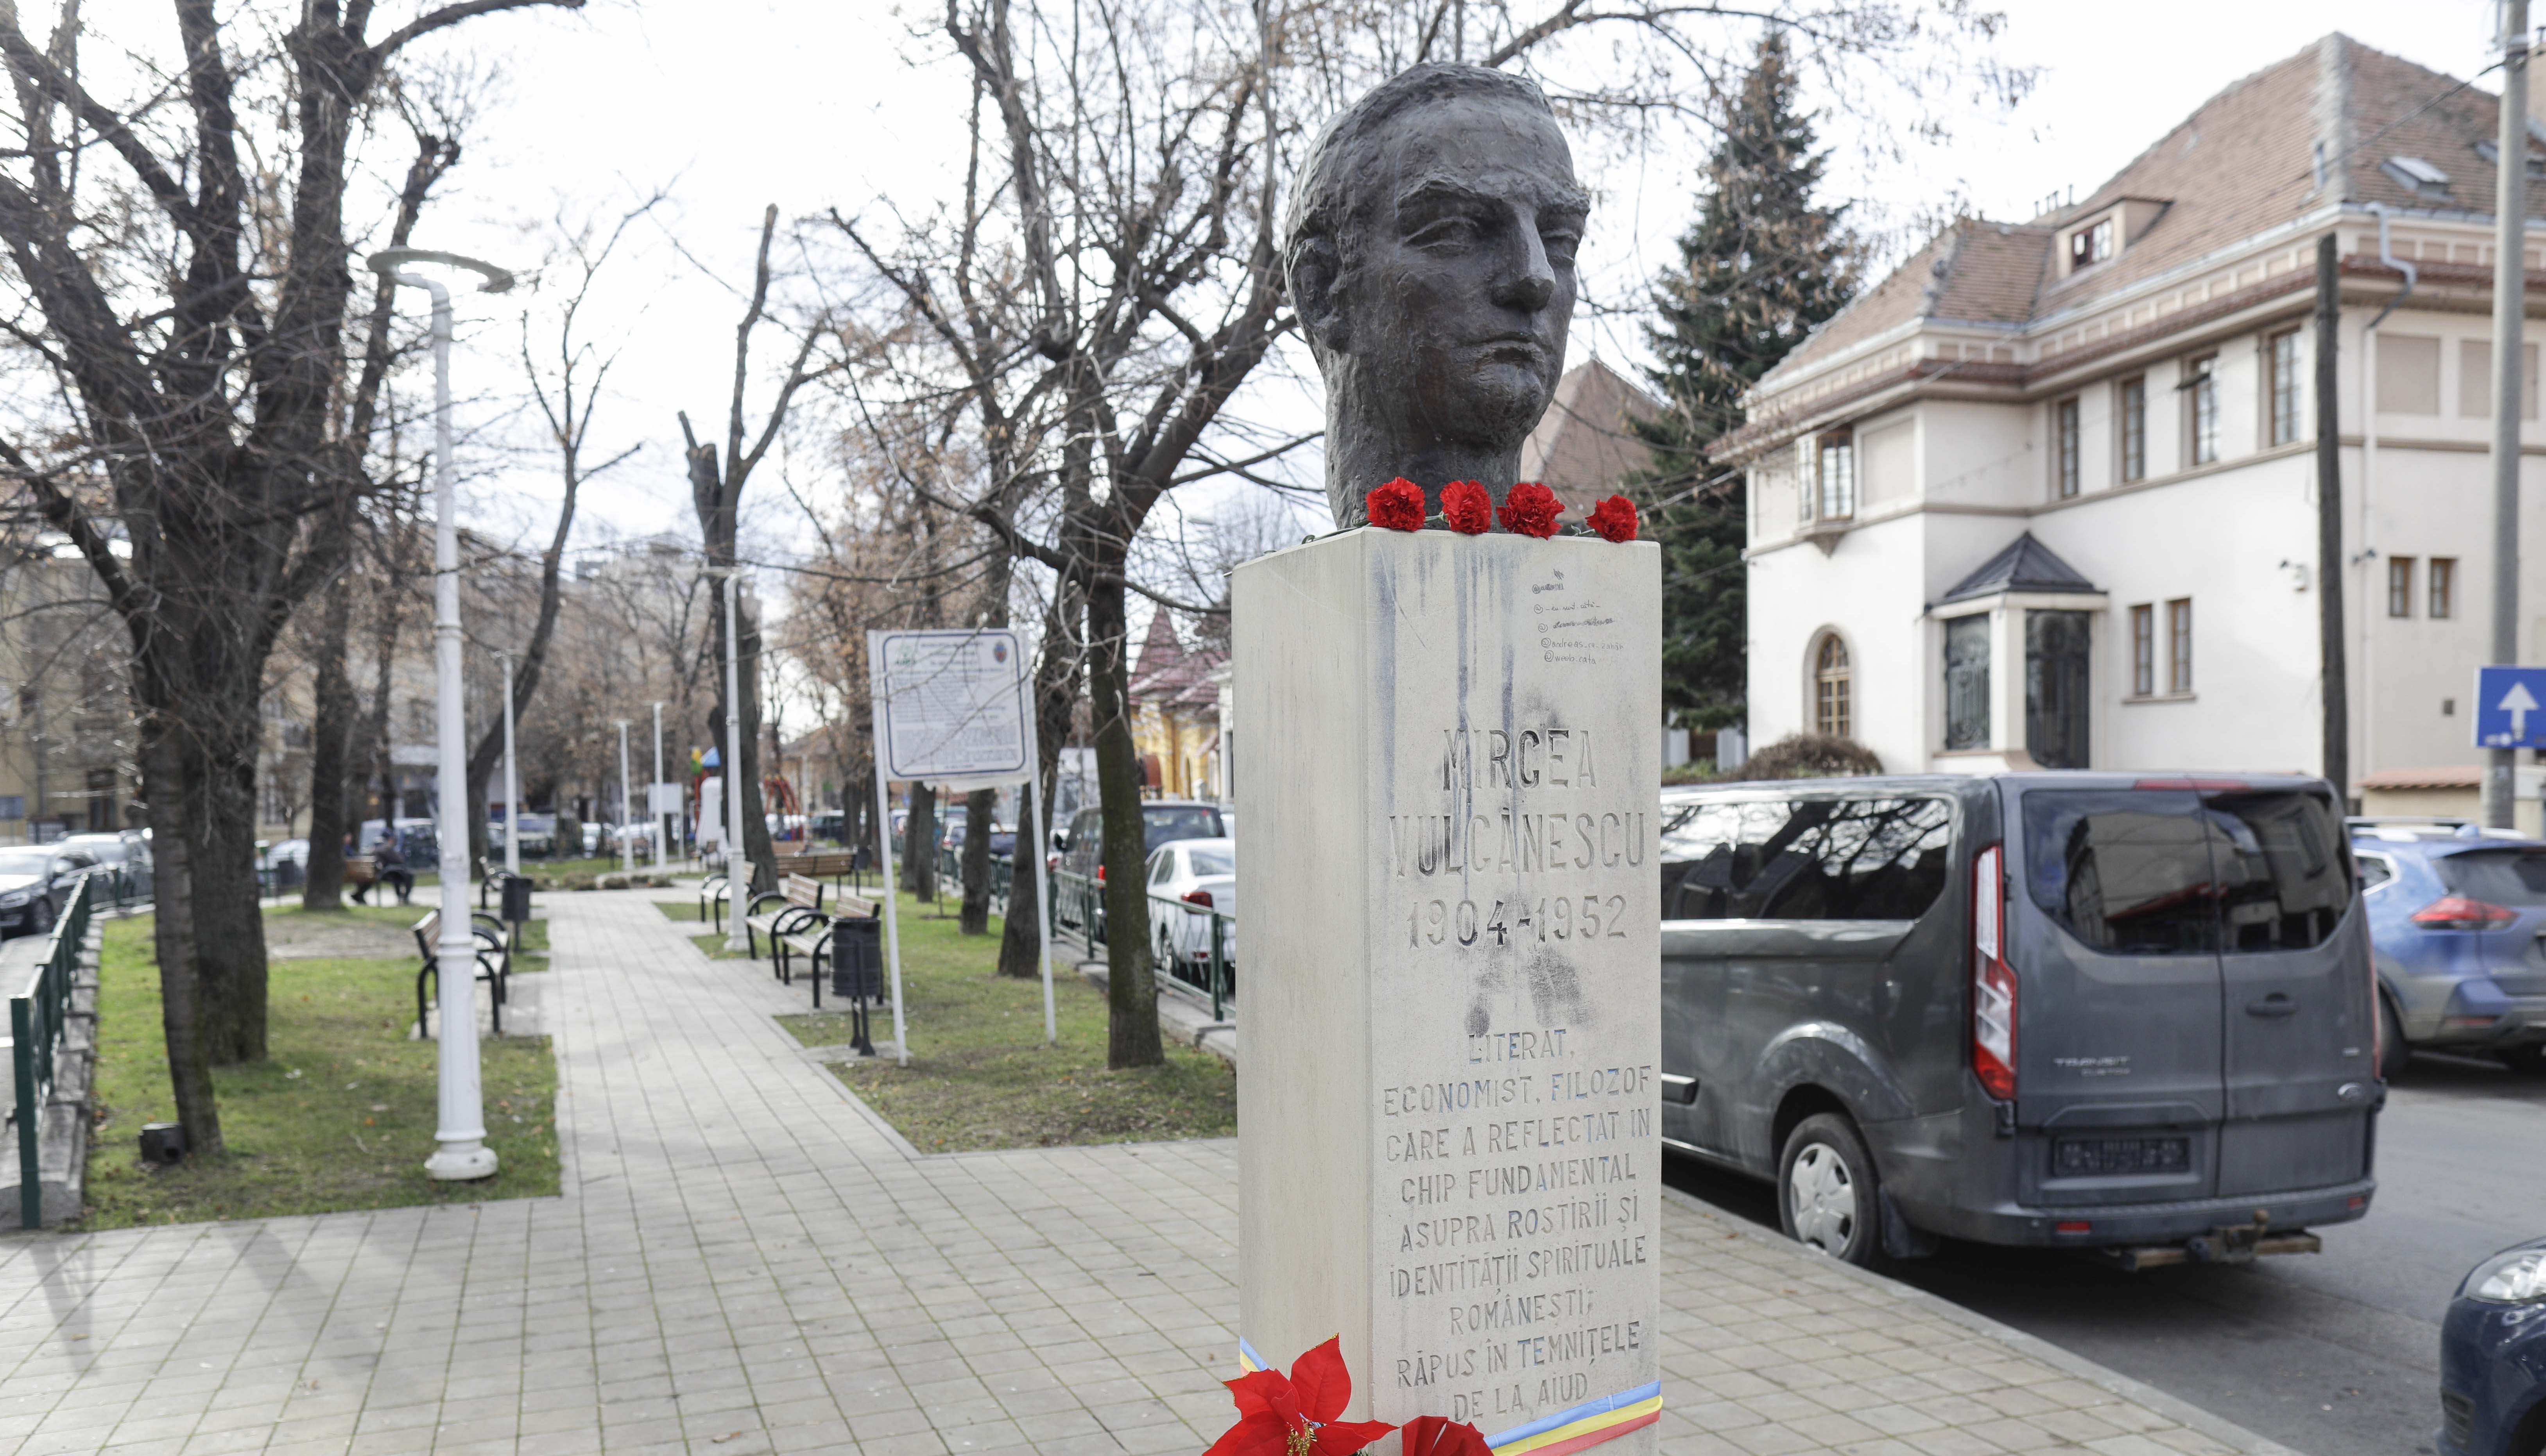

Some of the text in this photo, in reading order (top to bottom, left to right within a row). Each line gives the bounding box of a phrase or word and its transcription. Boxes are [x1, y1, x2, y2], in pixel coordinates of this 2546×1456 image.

[1443, 729, 1597, 791] MIRCEA
[1389, 807, 1645, 877] VULCĂNESCU
[1407, 894, 1628, 949] 1904-1952
[1468, 1029, 1575, 1064] LITERAT,
[2054, 1056, 2130, 1067] TRANSIT
[1384, 1065, 1652, 1118] ECONOMIST, FILOZOF
[1386, 1108, 1650, 1162] CARE A REFLECTAT IN
[1401, 1153, 1637, 1206] CHIP FUNDAMENTAL
[1400, 1213, 1496, 1253] ASUPRA
[1396, 1348, 1476, 1390] RĂPUS
[1486, 1338, 1508, 1374] ÎN
[1453, 1390, 1484, 1422] DE
[1495, 1384, 1525, 1415] LA
